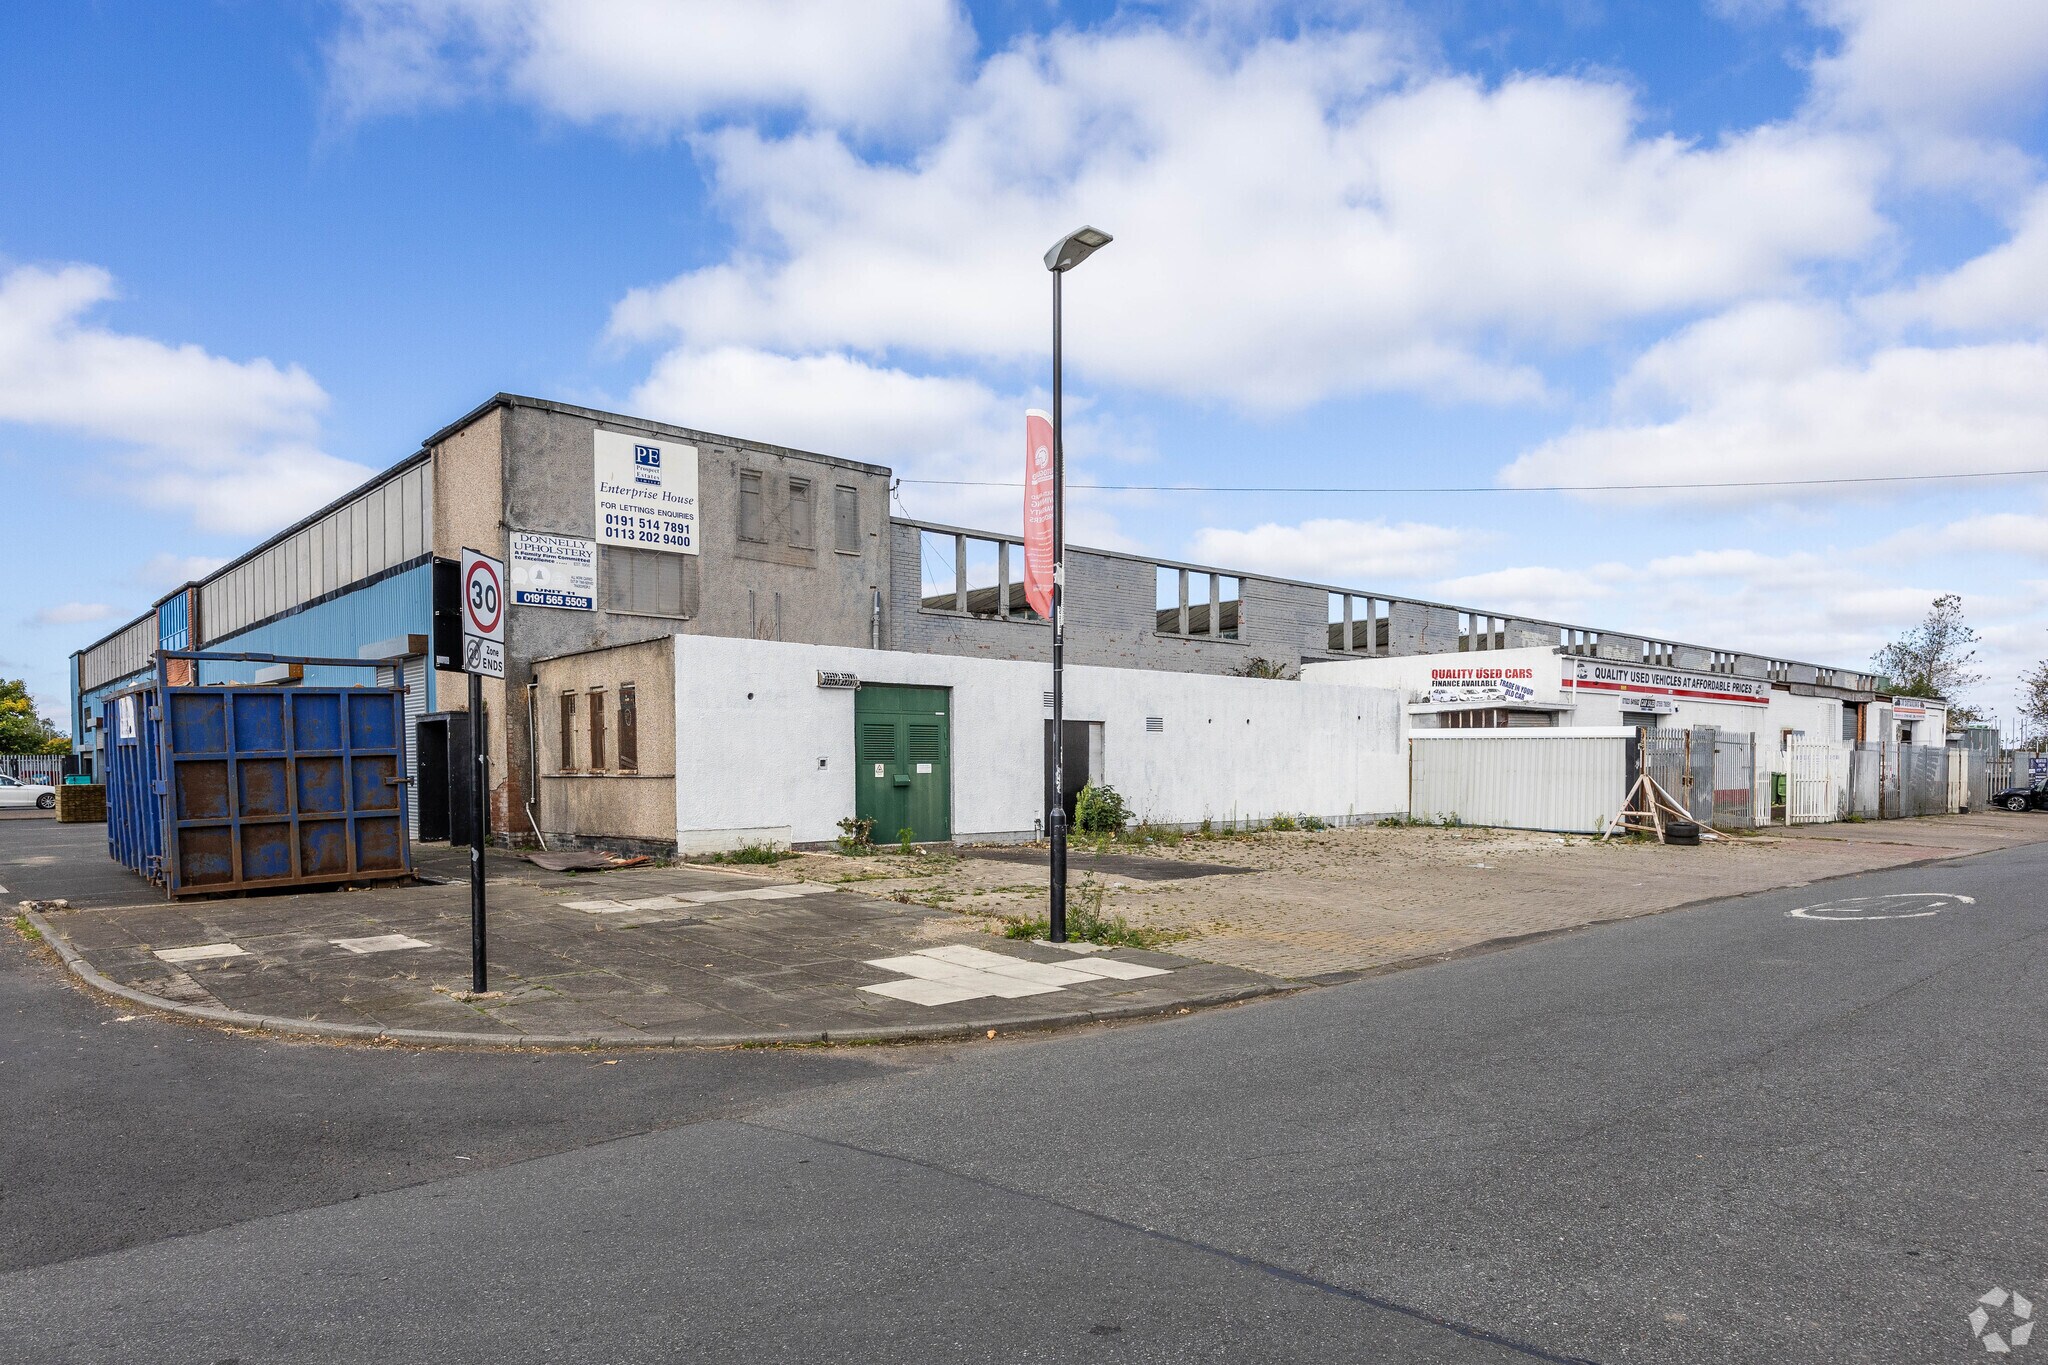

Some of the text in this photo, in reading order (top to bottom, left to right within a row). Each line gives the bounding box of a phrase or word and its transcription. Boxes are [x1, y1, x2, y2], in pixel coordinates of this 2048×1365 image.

[636, 447, 660, 465] PE
[636, 472, 660, 480] Estates
[600, 482, 694, 505] Enterprise House
[601, 502, 694, 520] FOR LETTINGS ENQUIRIES
[606, 514, 690, 534] 0191 514 7891
[520, 534, 587, 549] DONNELLY
[606, 527, 690, 547] 0113 202 9400
[514, 542, 593, 558] UPHOLSTERY
[558, 555, 590, 563] Committed
[472, 580, 496, 613] 30
[524, 593, 587, 607] 0191 565 5505
[486, 646, 499, 657] Zone
[483, 658, 503, 672] ENDS
[1432, 668, 1533, 680] QUALITY USED CARS
[1595, 667, 1752, 694] QUALITY USED VEHICLES AT AFFORDABLE PRICES
[1500, 679, 1515, 690] TRADE
[1521, 686, 1534, 696] YOUR
[1515, 692, 1525, 700] CAR
